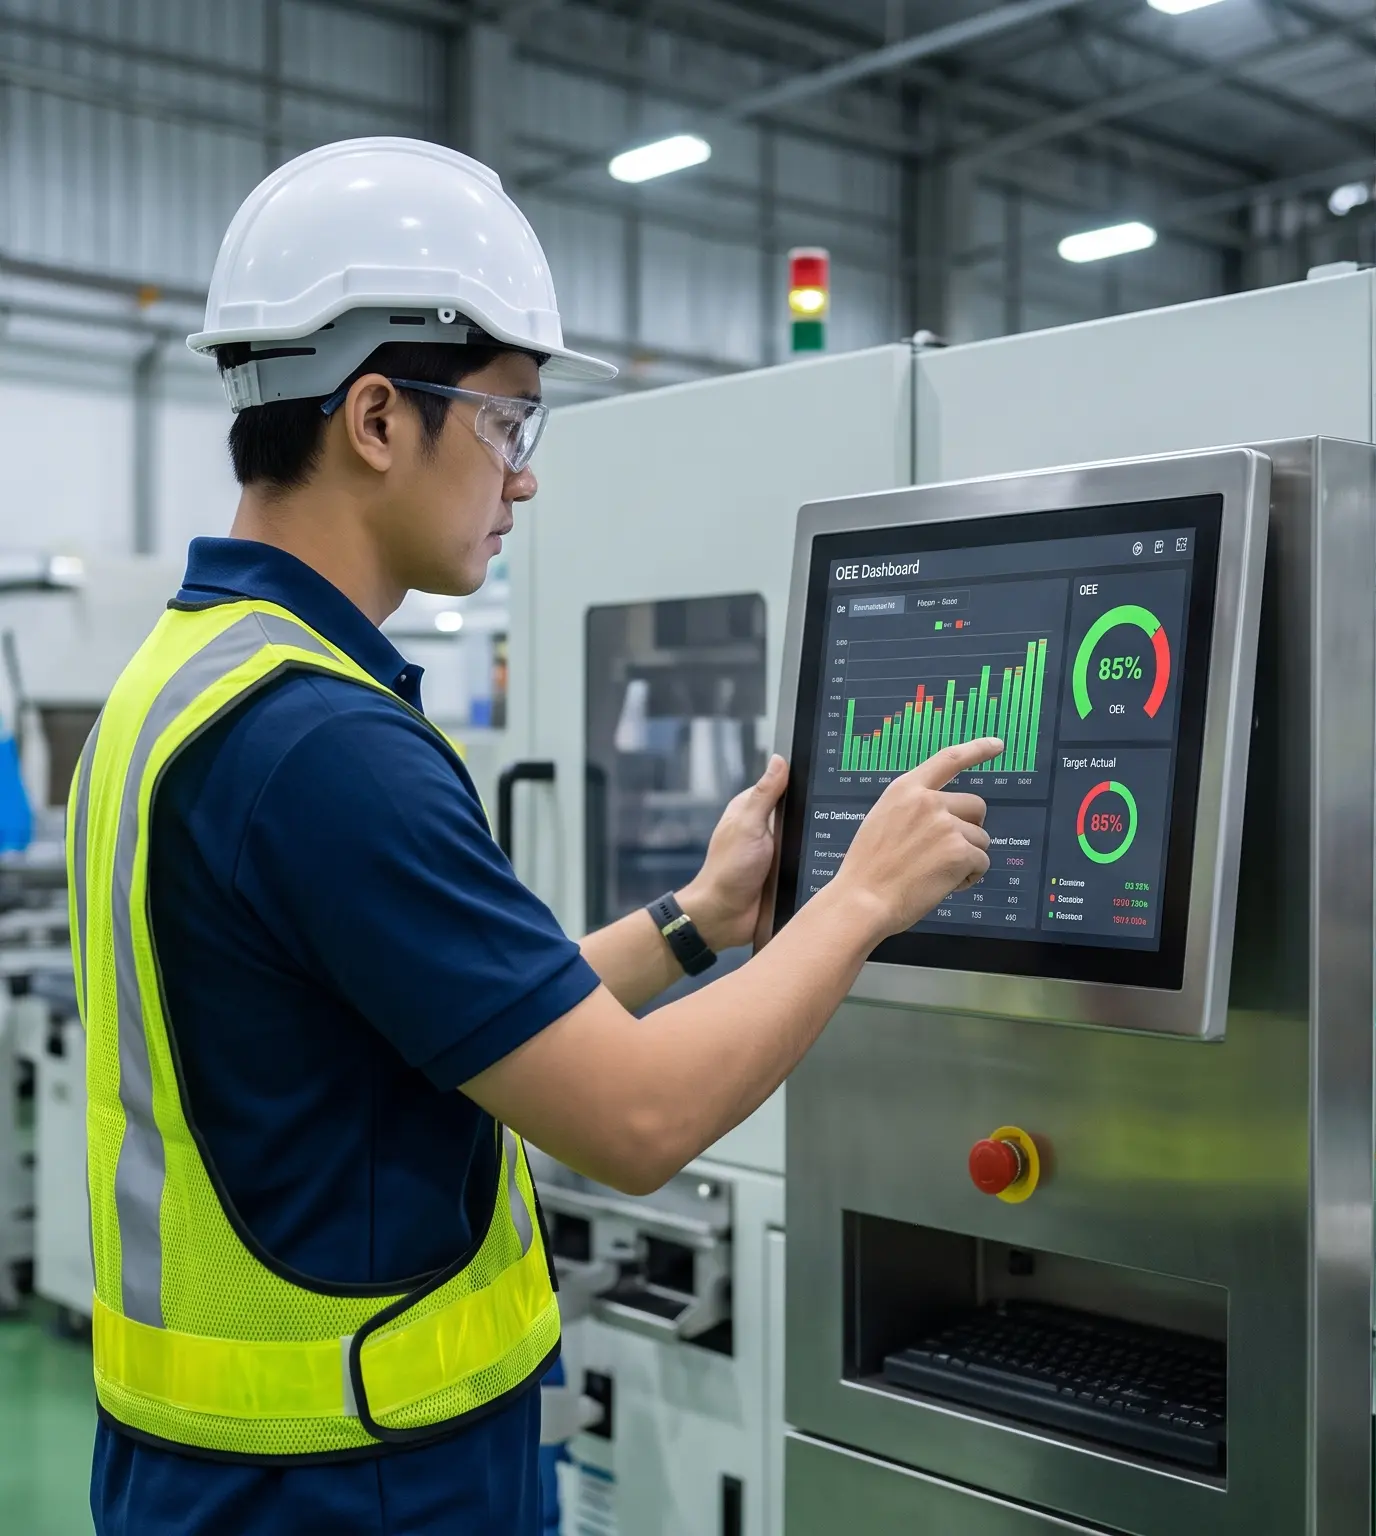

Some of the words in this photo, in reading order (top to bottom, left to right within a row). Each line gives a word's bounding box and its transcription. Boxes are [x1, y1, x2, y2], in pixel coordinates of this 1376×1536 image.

[835, 564, 860, 581] OEE
[861, 559, 920, 579] Dashboard
[1079, 583, 1099, 596] OEE
[1098, 655, 1143, 681] 85%
[1062, 757, 1088, 770] Target
[1090, 757, 1117, 769] Actual
[1090, 813, 1123, 833] 85%
